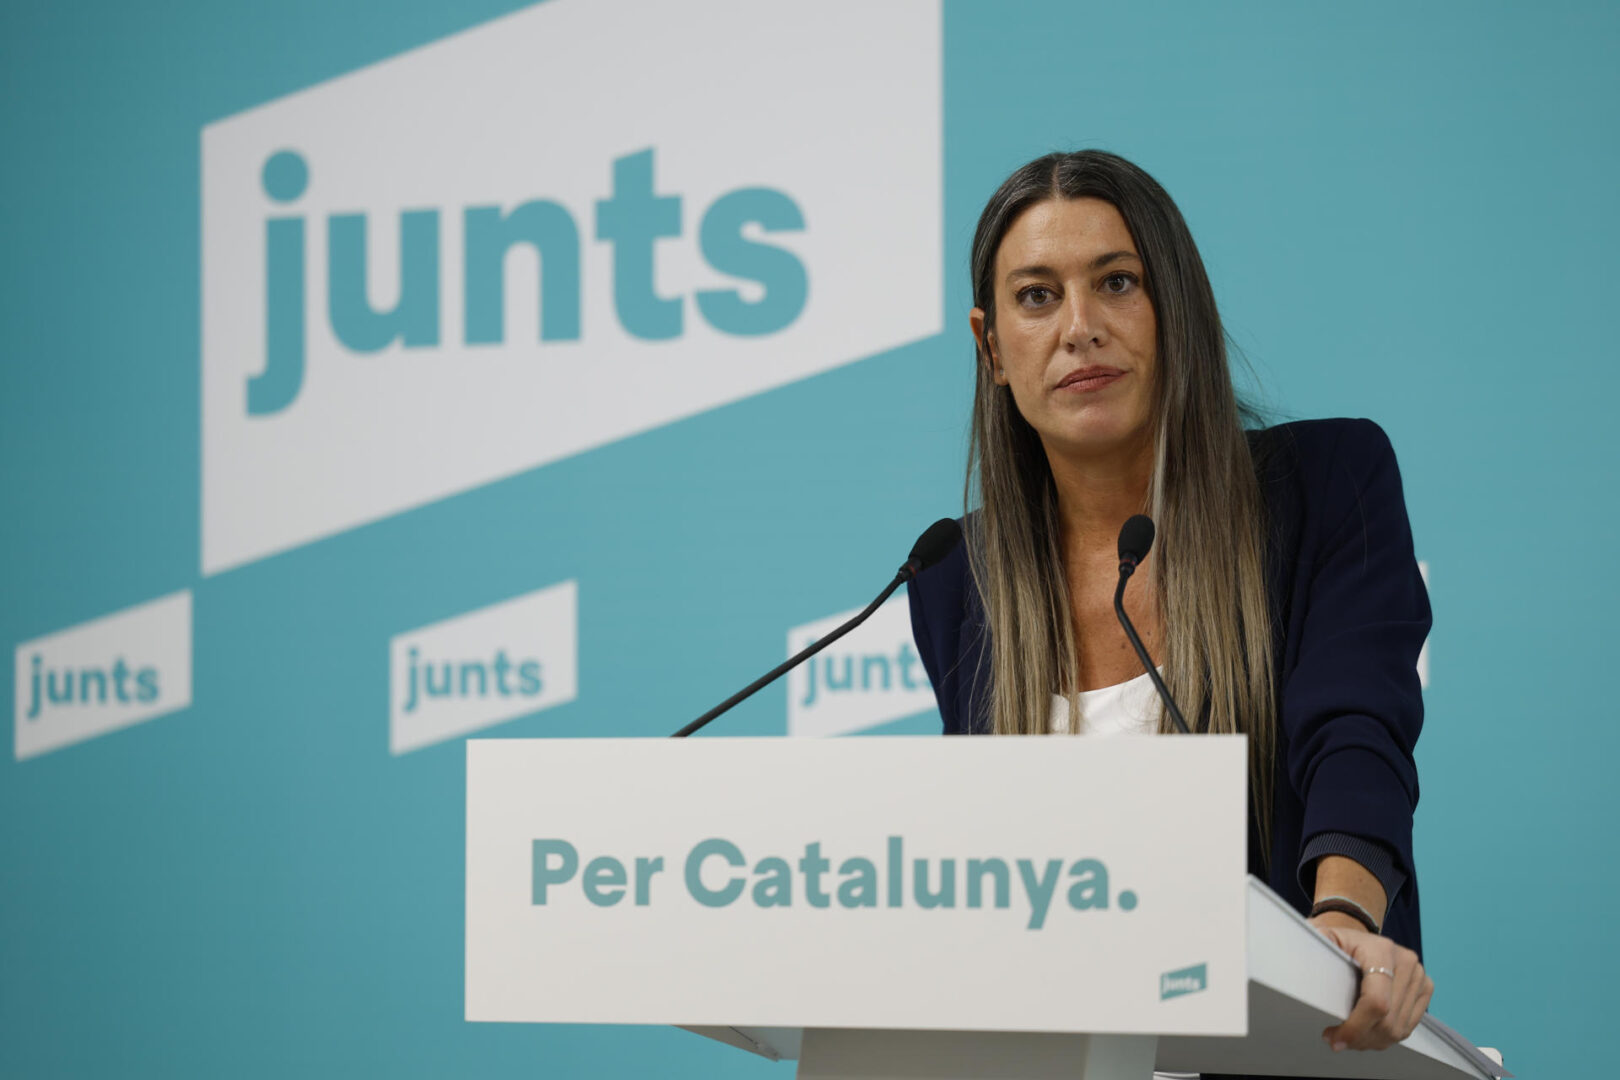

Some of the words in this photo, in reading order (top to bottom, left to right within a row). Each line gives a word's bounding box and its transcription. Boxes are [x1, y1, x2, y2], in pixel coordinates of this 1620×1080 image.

[245, 147, 809, 419] junts
[26, 653, 161, 721] junts
[402, 645, 545, 714] junts
[801, 637, 934, 708] junt
[531, 838, 664, 908] Per
[683, 836, 1139, 931] Catalunya.
